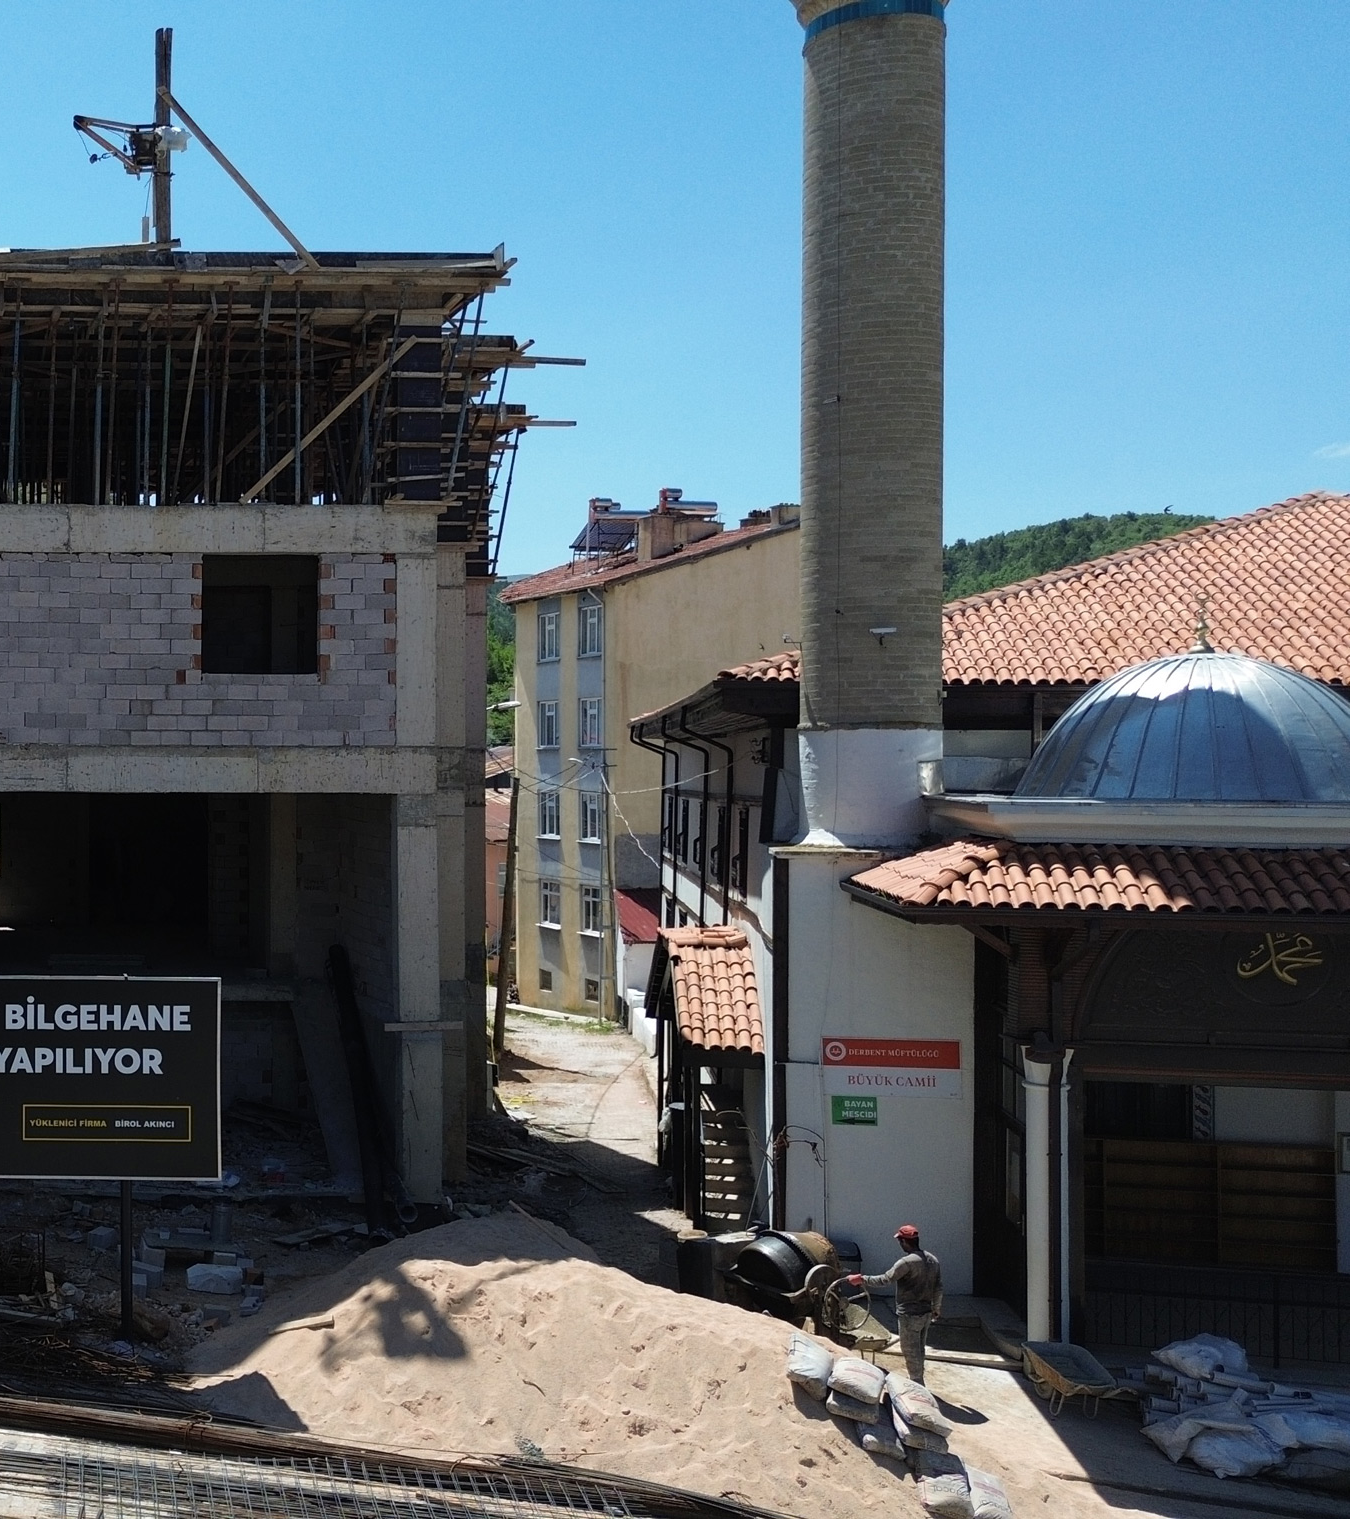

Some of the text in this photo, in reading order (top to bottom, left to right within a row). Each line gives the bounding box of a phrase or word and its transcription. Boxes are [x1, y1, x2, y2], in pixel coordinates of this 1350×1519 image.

[5, 995, 192, 1032] BİLGEHANE
[848, 1048, 940, 1058] DERBENT MÜFTÜLÜĞÜ
[847, 1073, 937, 1088] BÜYÜK CAMİİ
[844, 1100, 874, 1109] BAYAN
[29, 1118, 175, 1128] YÜKLENİCİ FİRMA BİROL AKINCI
